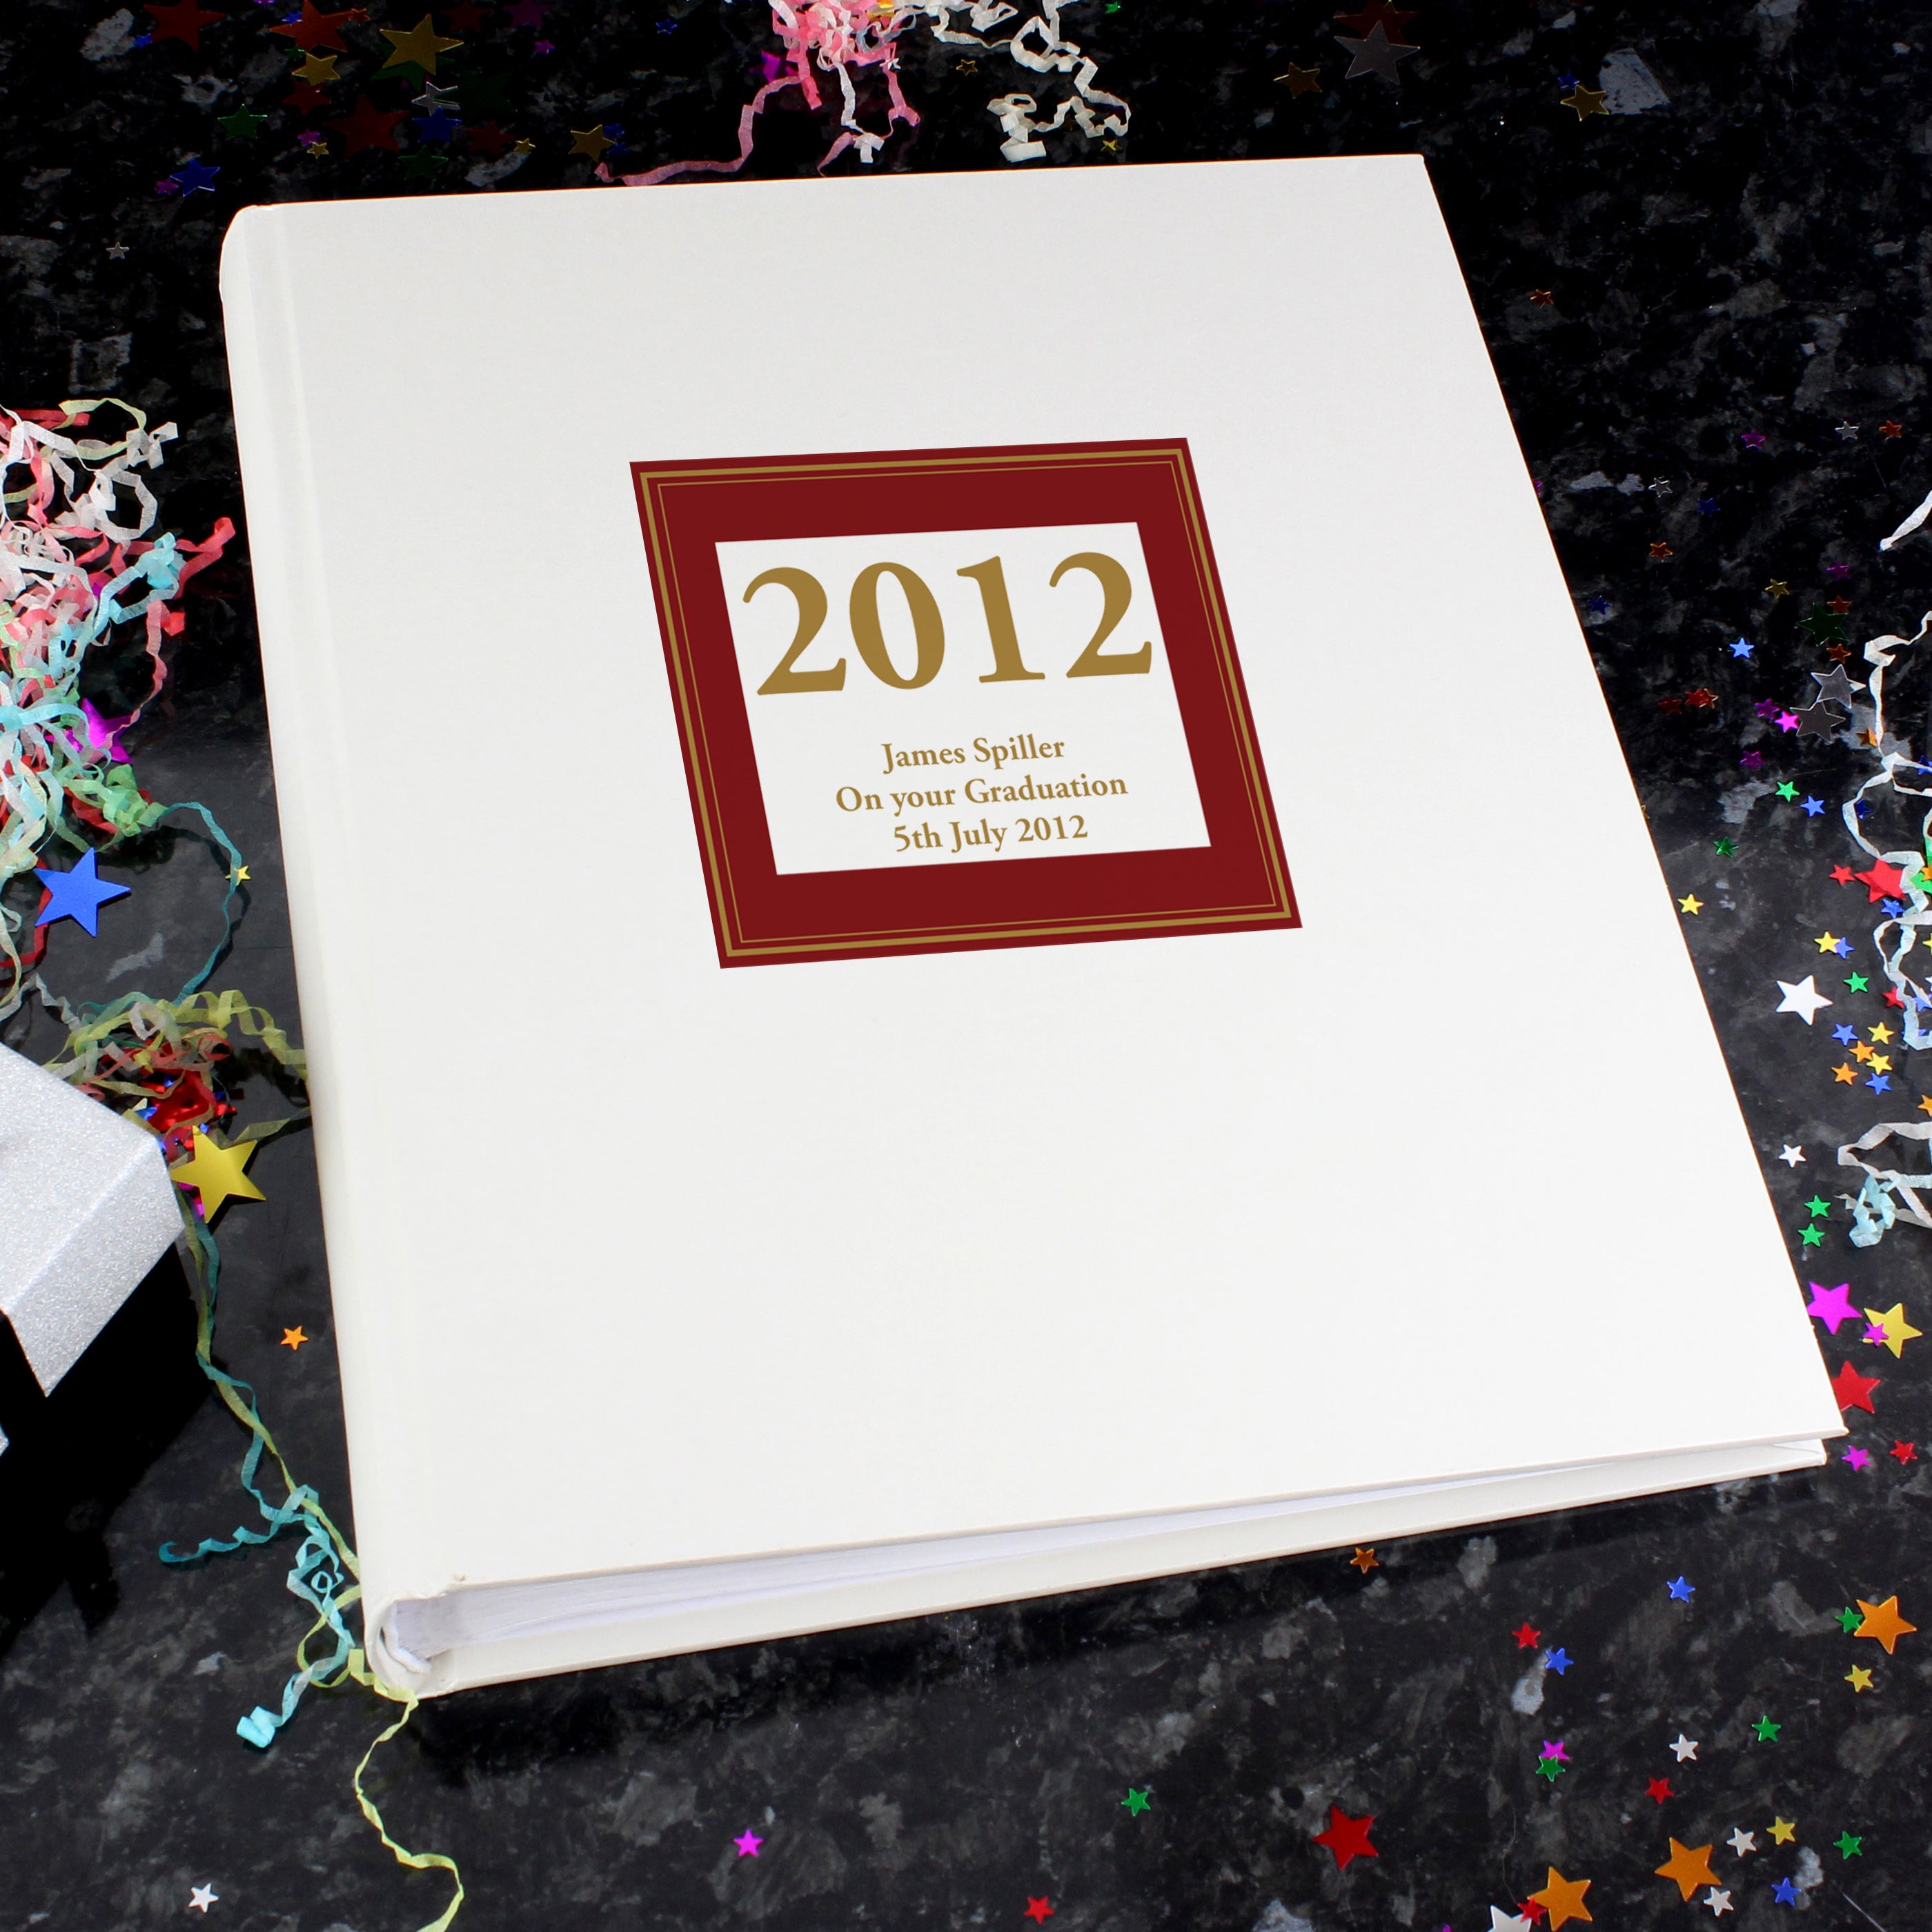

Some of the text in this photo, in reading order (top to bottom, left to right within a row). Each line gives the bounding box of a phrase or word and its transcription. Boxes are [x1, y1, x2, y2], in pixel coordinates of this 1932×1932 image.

[742, 551, 1152, 696] 2012
[881, 733, 1065, 775] James Spiller
[836, 773, 1128, 818] On your Graduation
[894, 814, 1088, 854] 5th July 2012
